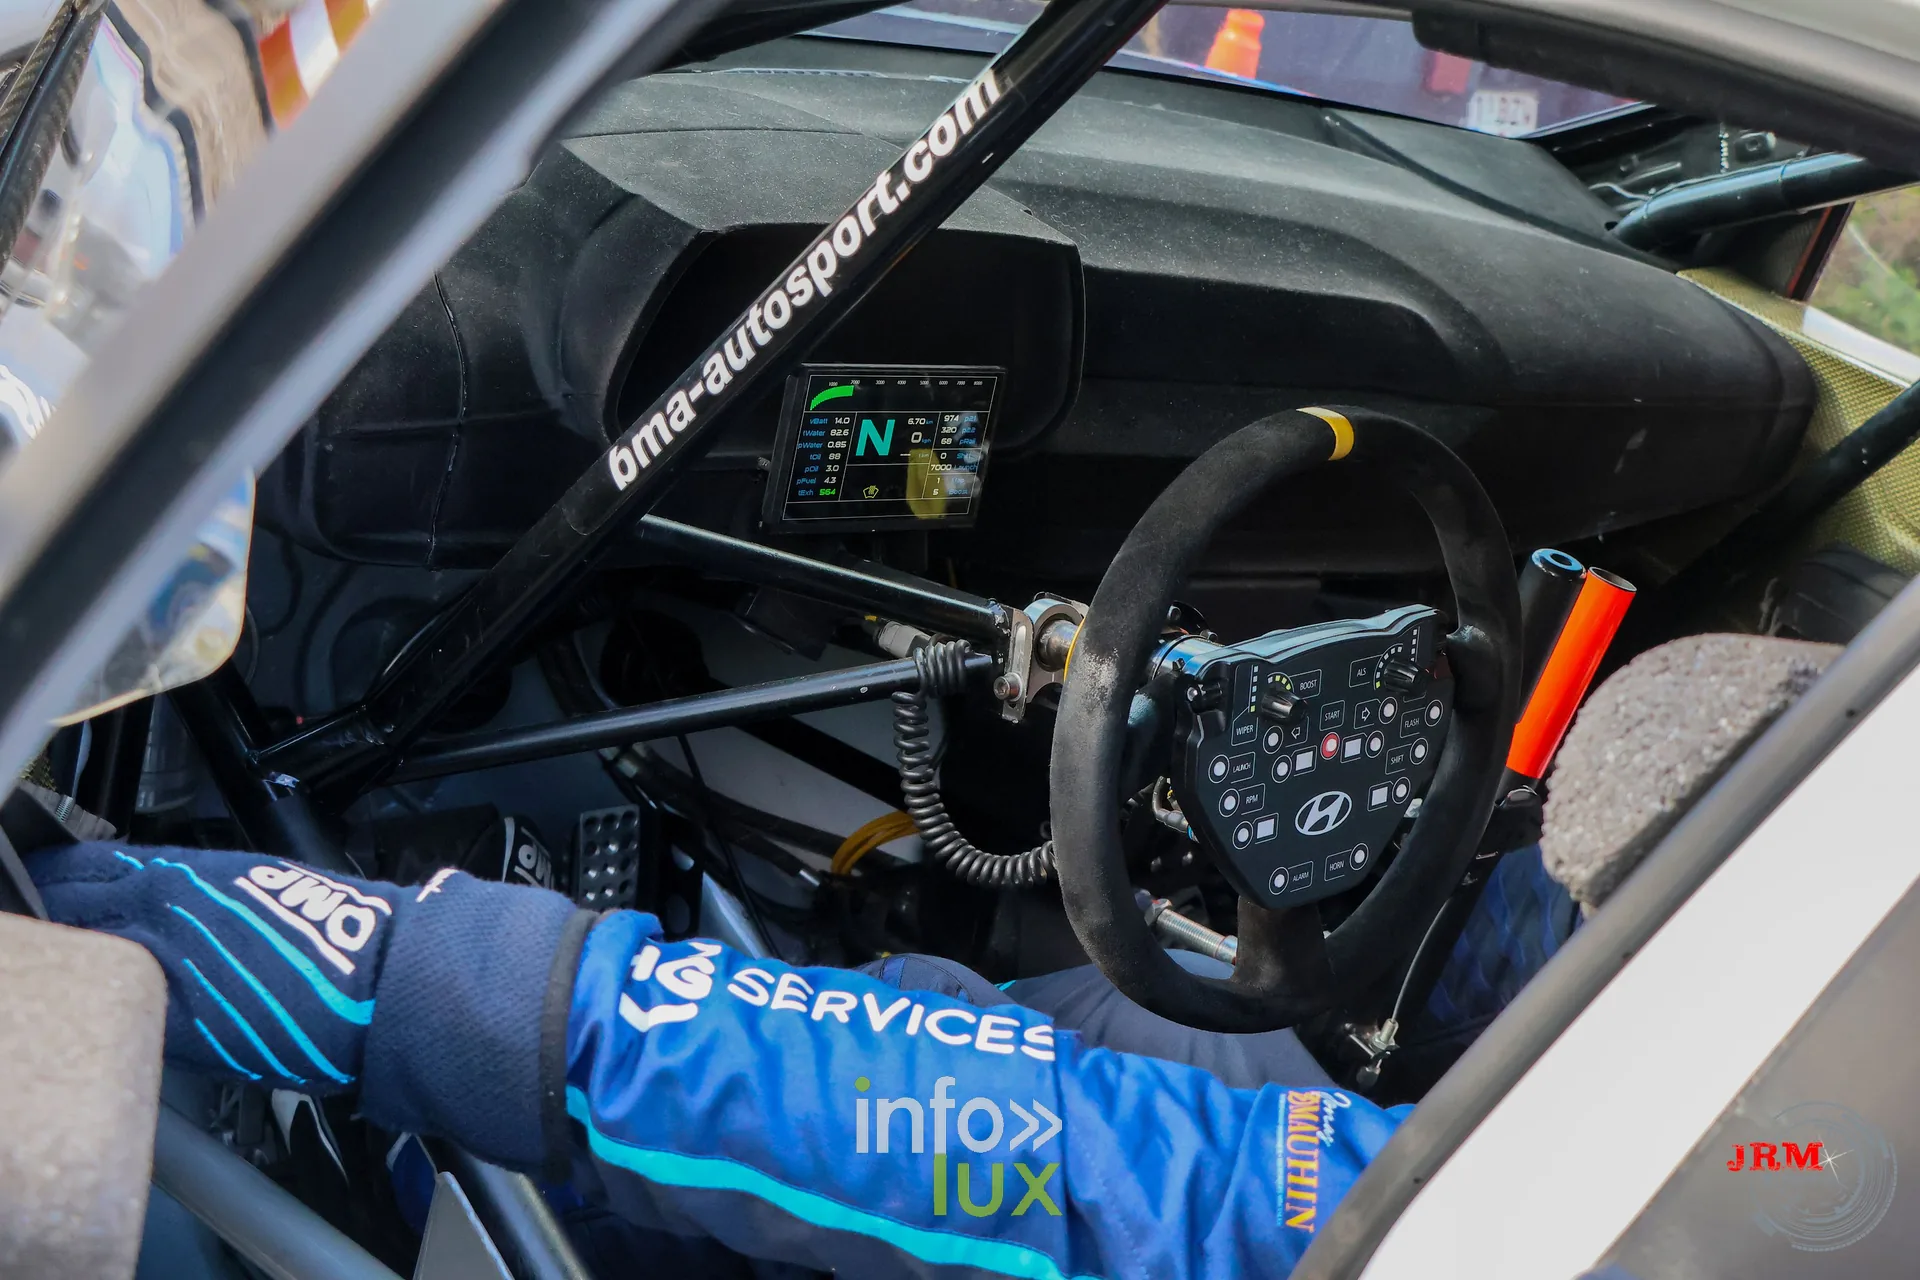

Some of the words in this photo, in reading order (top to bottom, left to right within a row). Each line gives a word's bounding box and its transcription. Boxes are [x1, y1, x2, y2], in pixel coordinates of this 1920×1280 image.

[607, 69, 1000, 492] bma-autosport.com
[855, 419, 896, 456] N
[910, 432, 922, 444] 0
[1356, 667, 1366, 678] ALS
[1300, 680, 1318, 690] BOOST
[1324, 710, 1340, 722] START
[1404, 718, 1420, 729] FLASH
[1236, 724, 1254, 736] WIPER
[1390, 754, 1404, 765] SHIFT
[1232, 762, 1252, 773] LAUNCH
[1246, 794, 1258, 804] RPM
[1329, 860, 1344, 872] HORN
[1292, 872, 1310, 882] ALARM
[246, 864, 378, 953] OMP
[726, 966, 1057, 1062] SERVICES
